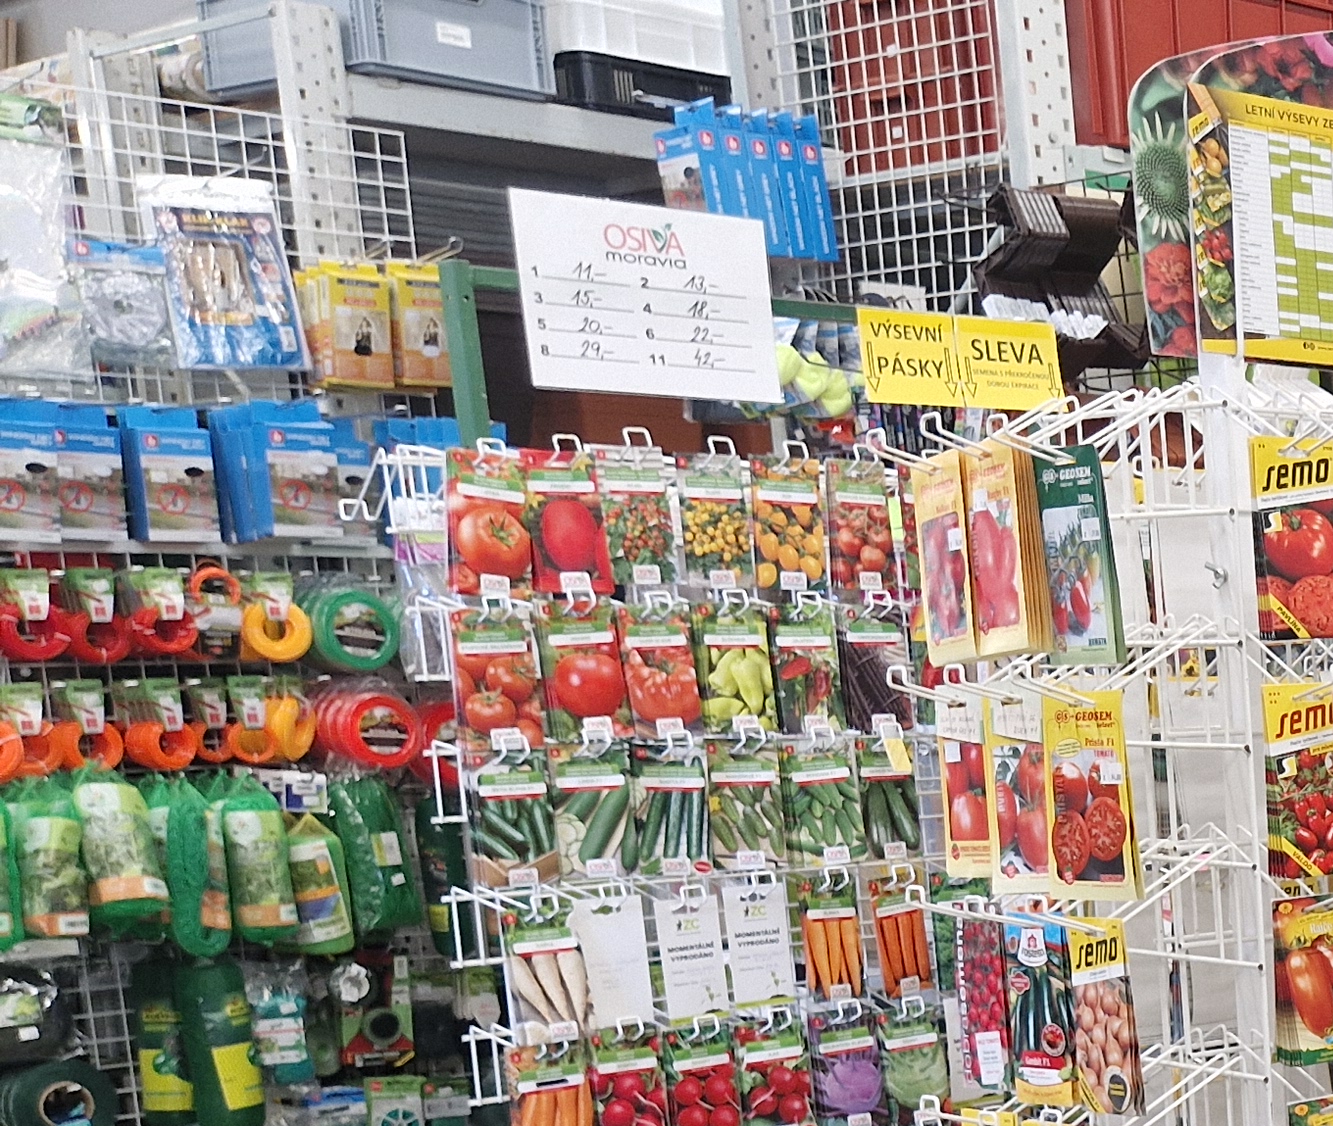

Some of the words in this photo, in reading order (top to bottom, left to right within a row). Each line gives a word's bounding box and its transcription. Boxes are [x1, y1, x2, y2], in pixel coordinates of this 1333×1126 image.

[1245, 103, 1275, 119] LETNÍ
[1277, 108, 1320, 128] VÝSEVY
[604, 223, 685, 258] OSIVA
[605, 251, 687, 270] moravia
[532, 266, 538, 278] 1
[640, 277, 649, 289] 2
[534, 292, 543, 304] 3
[643, 303, 652, 314] 4
[538, 319, 546, 330] 5
[870, 318, 943, 343] VÝSEVNÍ
[646, 328, 654, 340] 6
[541, 344, 549, 356] 8
[971, 338, 1044, 366] SLEVA
[650, 355, 666, 366] 11
[877, 352, 944, 379] PÁSKY
[1262, 459, 1329, 491] semo
[1076, 936, 1119, 969] semo
